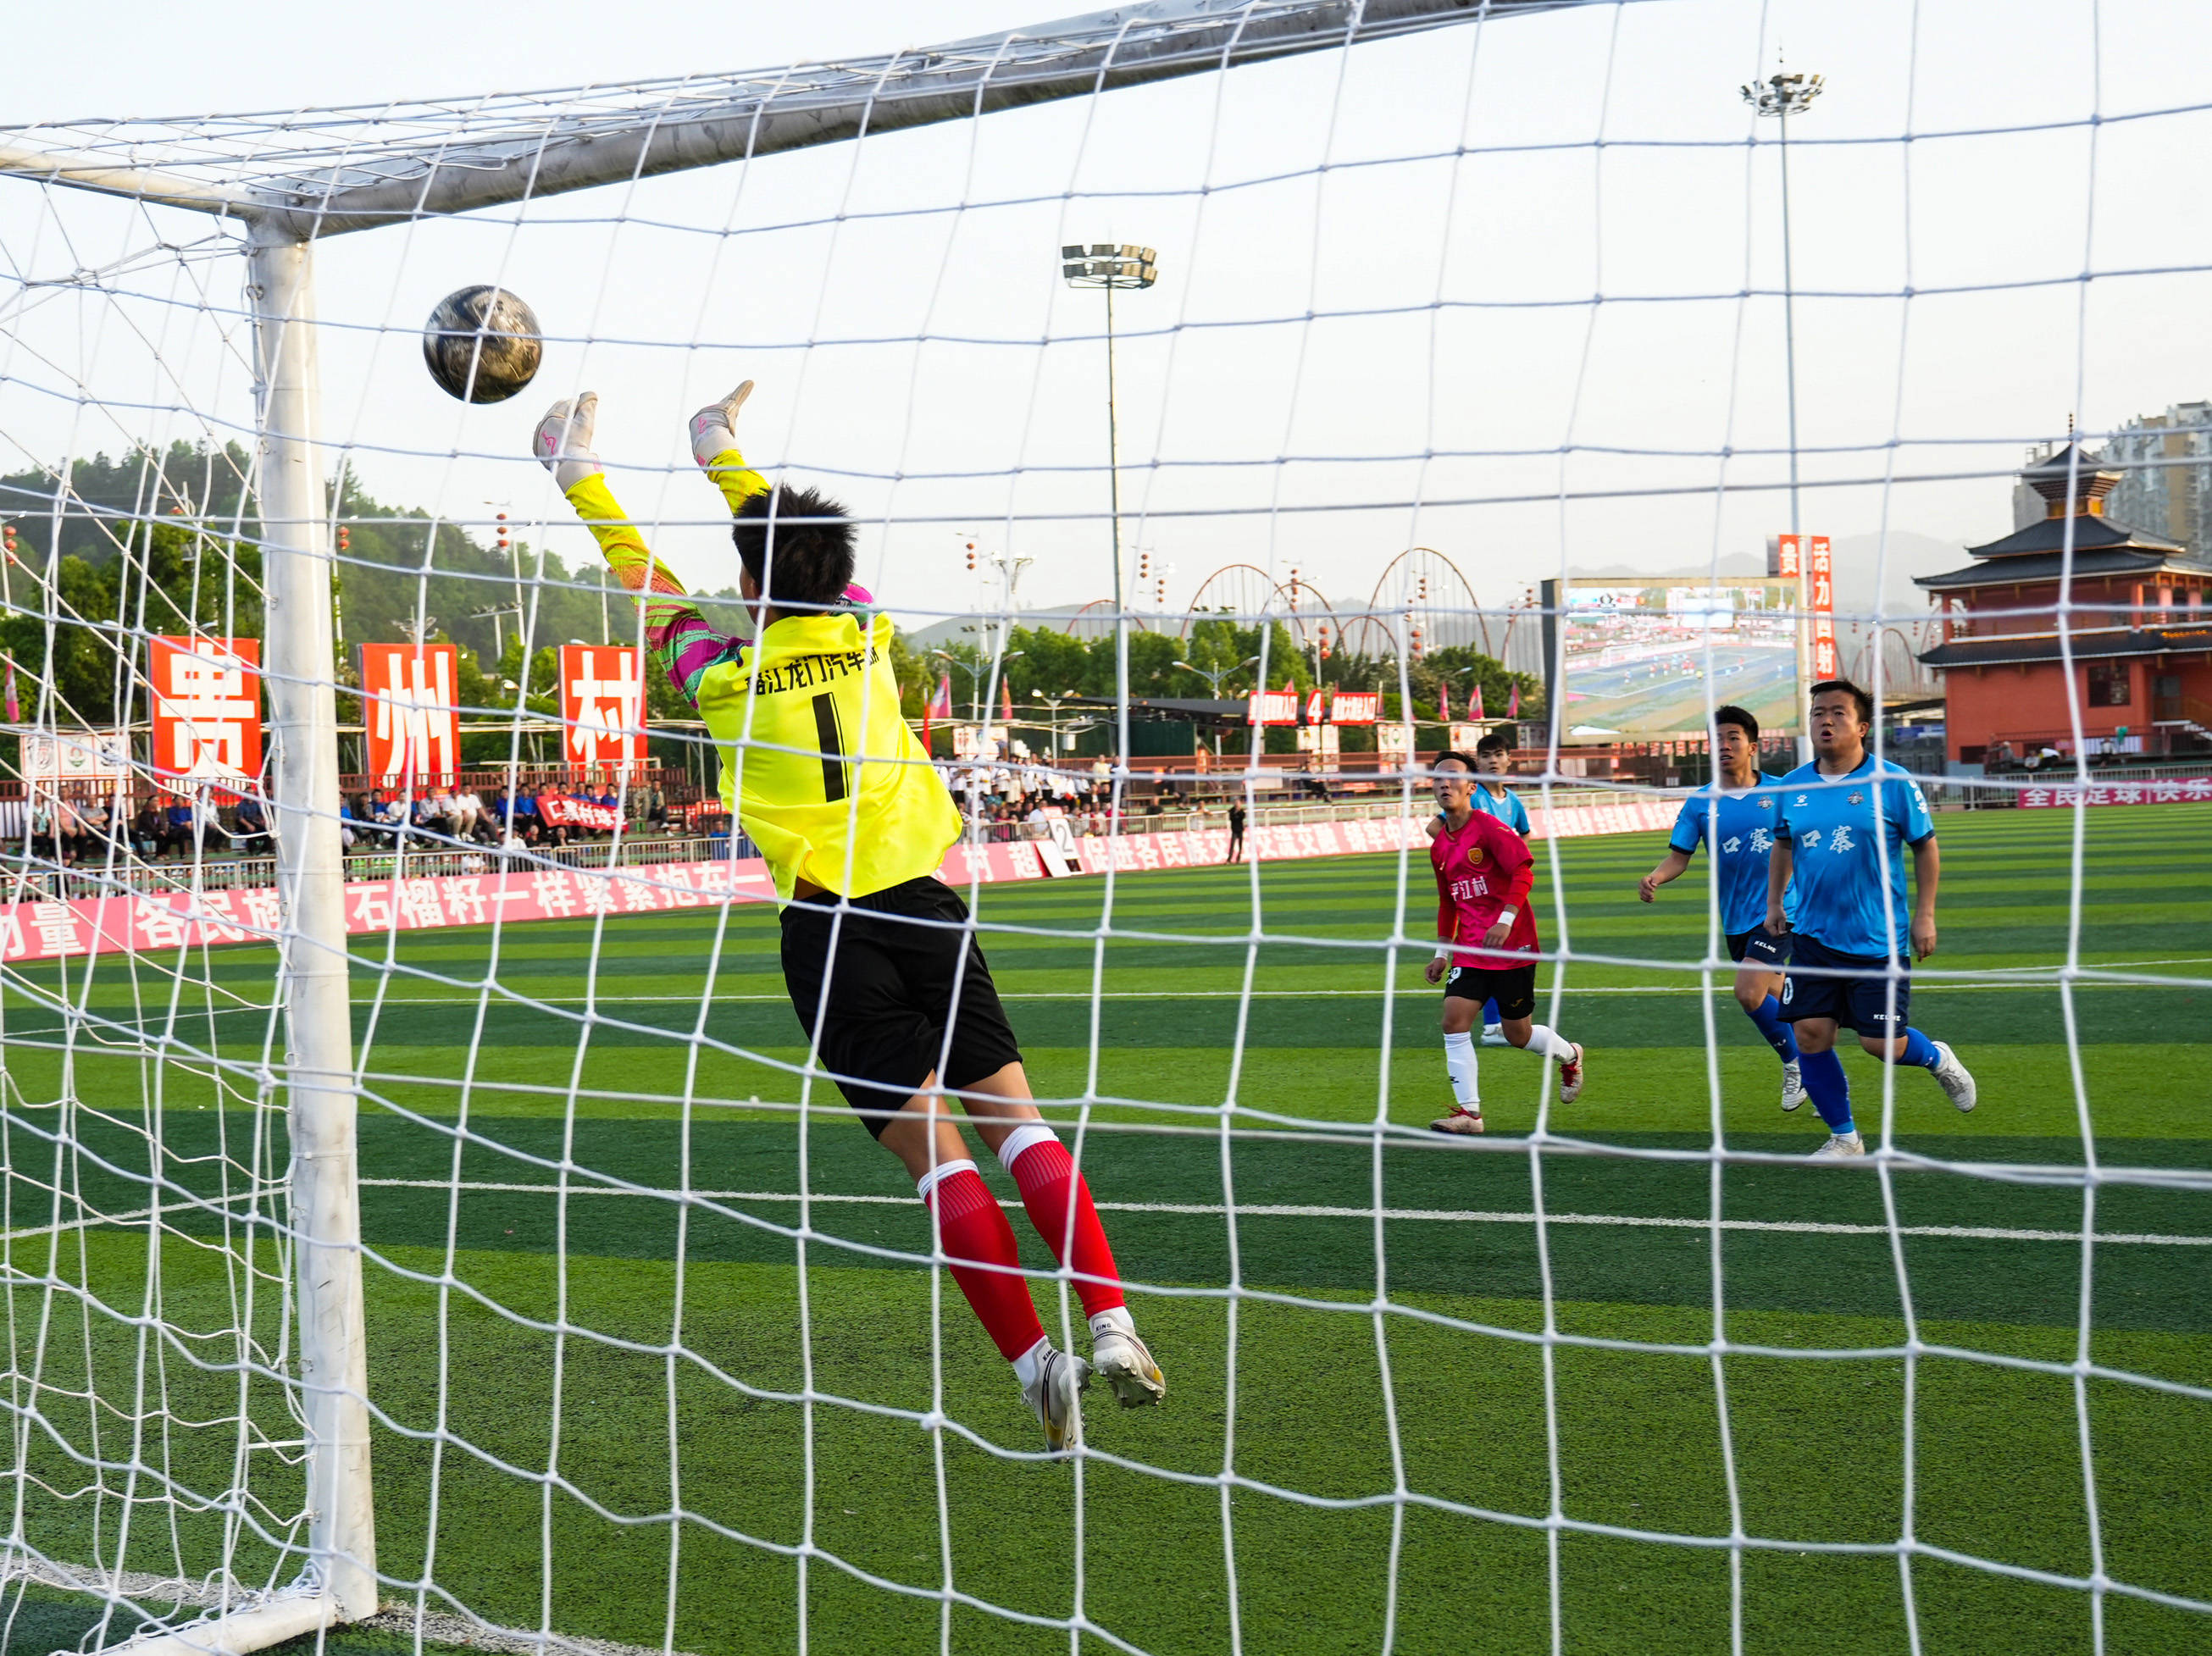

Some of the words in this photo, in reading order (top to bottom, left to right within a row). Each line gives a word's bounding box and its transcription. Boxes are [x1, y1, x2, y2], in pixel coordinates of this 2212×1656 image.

[1781, 541, 1798, 574] 贵
[1813, 542, 1835, 675] 活力四射
[158, 641, 255, 793] 贵
[376, 651, 455, 789] 州
[570, 651, 638, 783] 村
[1307, 692, 1322, 723] 4
[812, 691, 849, 803] 1
[1056, 824, 1073, 852] 2
[1721, 828, 1773, 854] 口寨
[1801, 824, 1855, 854] 口寨
[1754, 940, 1777, 954] KELME
[1095, 1322, 1112, 1332] KING
